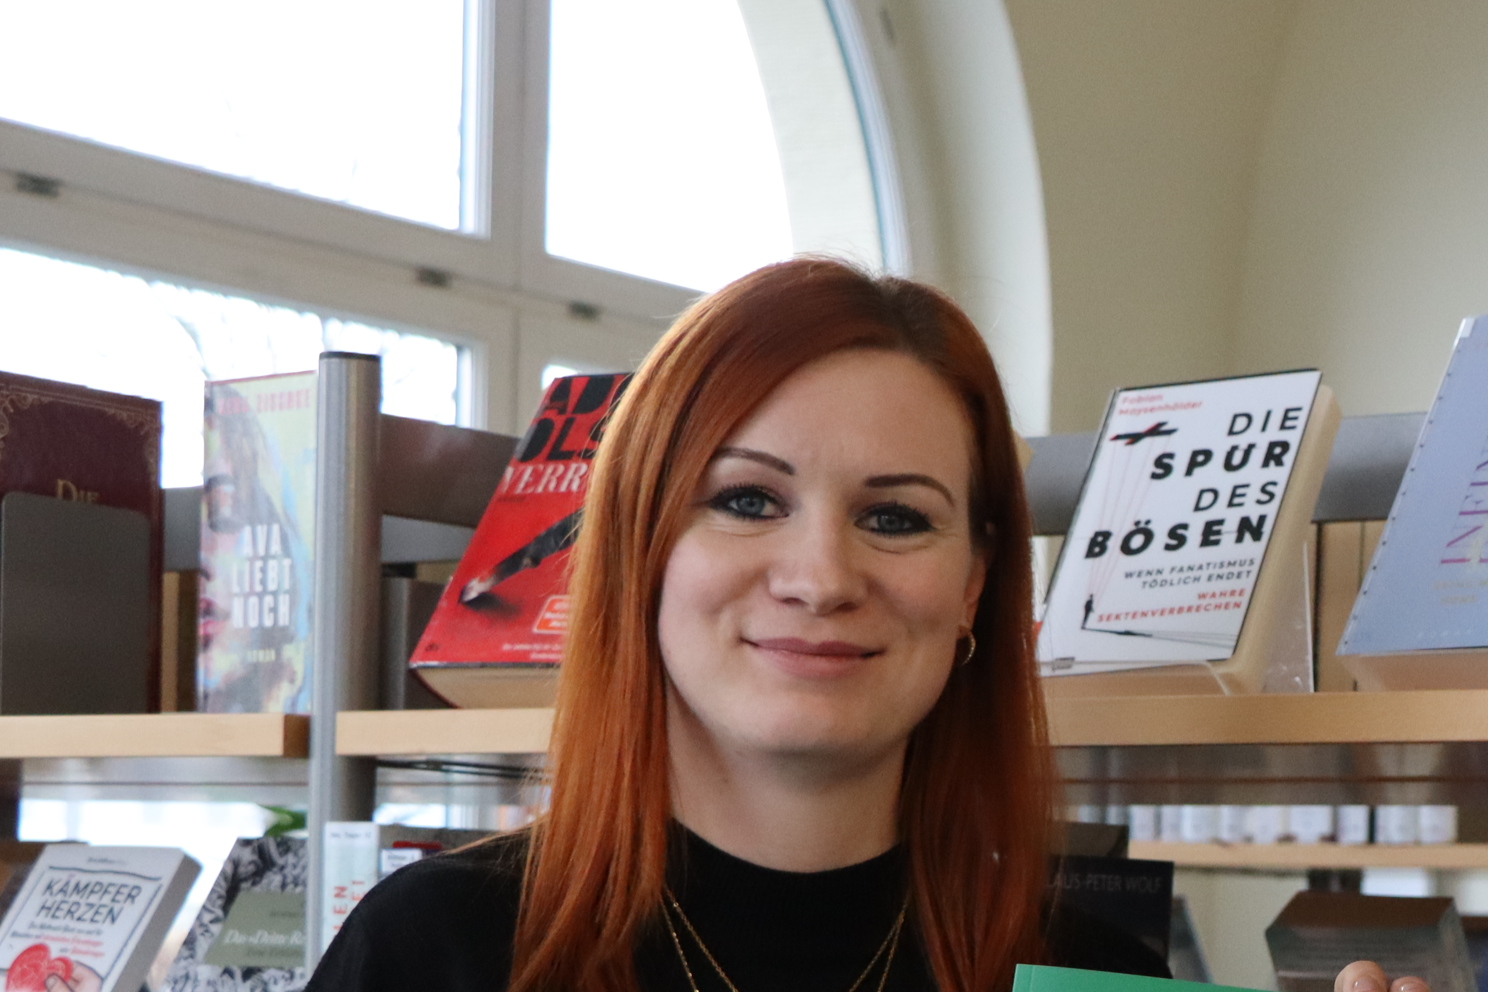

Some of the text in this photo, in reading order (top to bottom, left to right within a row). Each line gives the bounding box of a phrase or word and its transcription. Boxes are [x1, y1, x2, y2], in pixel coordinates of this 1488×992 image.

[1227, 406, 1303, 437] DIE
[1150, 440, 1291, 480] SPUR
[501, 463, 588, 494] VERR
[1193, 481, 1279, 513] DES
[242, 523, 283, 557] AVA
[1084, 514, 1268, 560] BÖSEN
[231, 558, 293, 594] LIEBT
[1124, 557, 1257, 580] WENN FANATISMUS
[1141, 570, 1254, 590] TÖDLICH ENDET
[1197, 587, 1247, 601] WAHRE
[232, 594, 291, 629] NOCH
[1097, 601, 1243, 624] SEKTENVERBRECHEN
[36, 900, 125, 926] HERZEN
